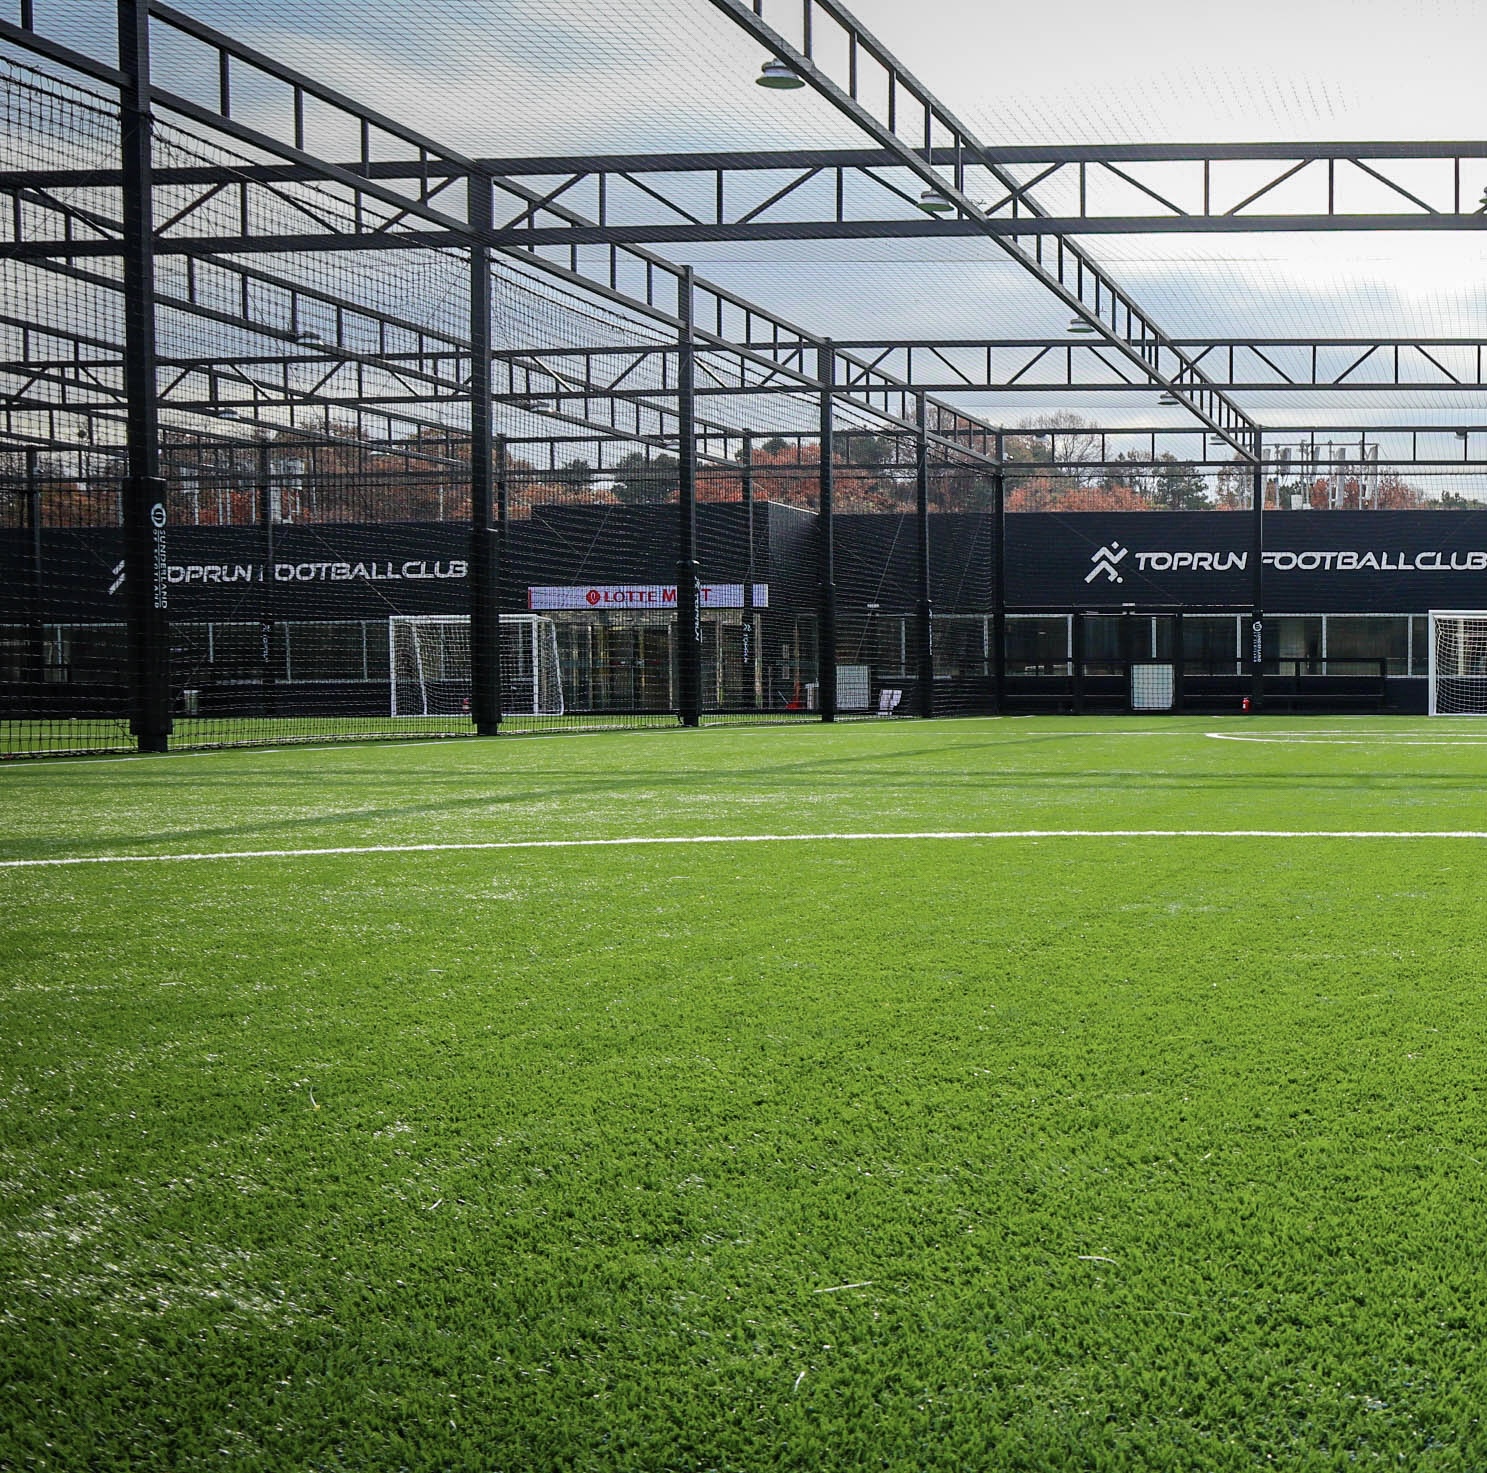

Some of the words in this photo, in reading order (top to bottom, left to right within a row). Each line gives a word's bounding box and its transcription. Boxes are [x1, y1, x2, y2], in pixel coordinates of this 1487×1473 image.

[159, 529, 168, 609] SUNDERLAND
[1135, 551, 1248, 571] TOPRUN
[166, 563, 253, 583] OPRUN
[603, 591, 657, 603] LOTTE
[662, 588, 712, 603] MT
